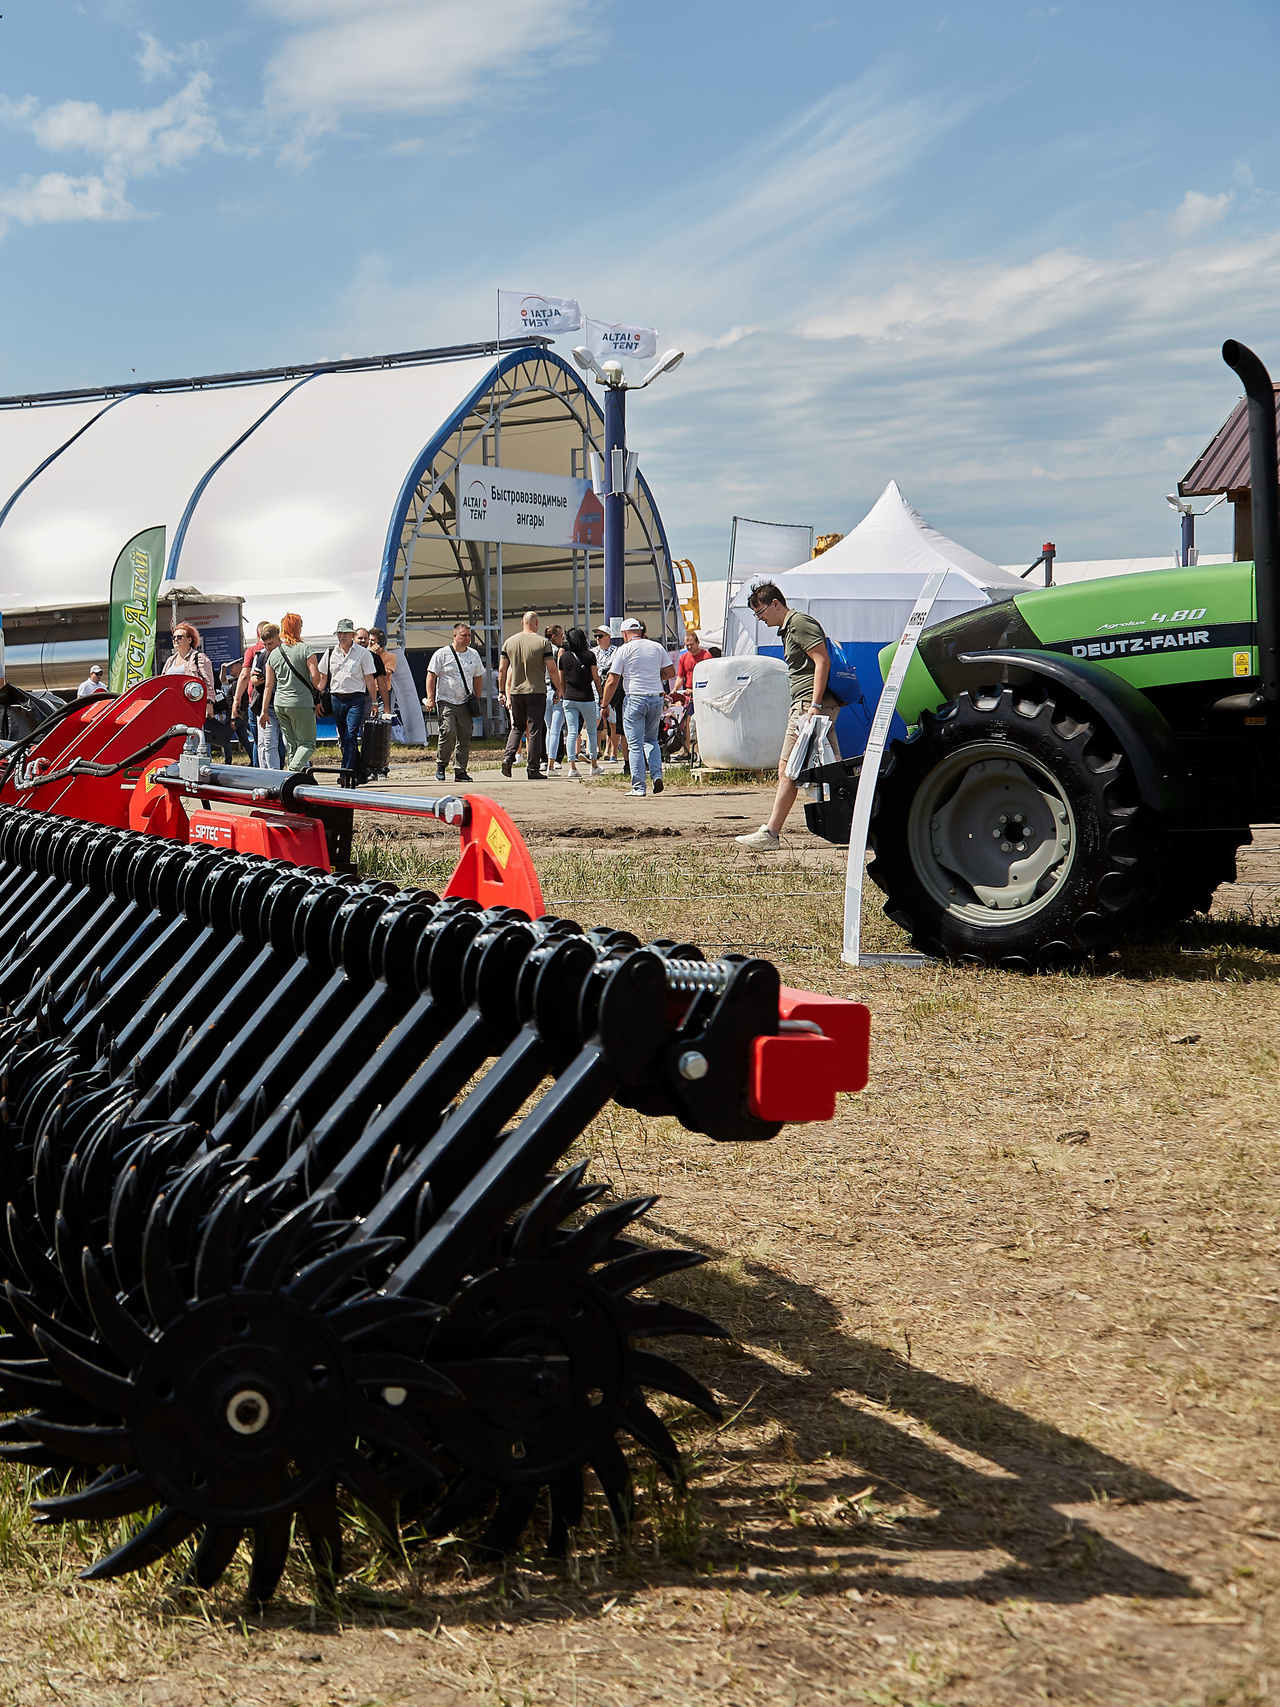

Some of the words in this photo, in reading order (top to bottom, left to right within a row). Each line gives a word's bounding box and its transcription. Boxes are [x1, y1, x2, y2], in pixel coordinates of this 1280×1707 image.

[602, 332, 631, 341] ALTAI
[613, 341, 640, 350] TENT
[462, 496, 481, 508] ALTAI
[491, 485, 568, 508] Быстровозводимые
[470, 509, 487, 521] TENT
[516, 513, 545, 529] ангары
[1096, 620, 1147, 632] Agrolux
[1150, 608, 1207, 623] 4.80
[1072, 630, 1210, 658] DEUTZ-FAHR
[195, 824, 219, 841] SIPTEC
